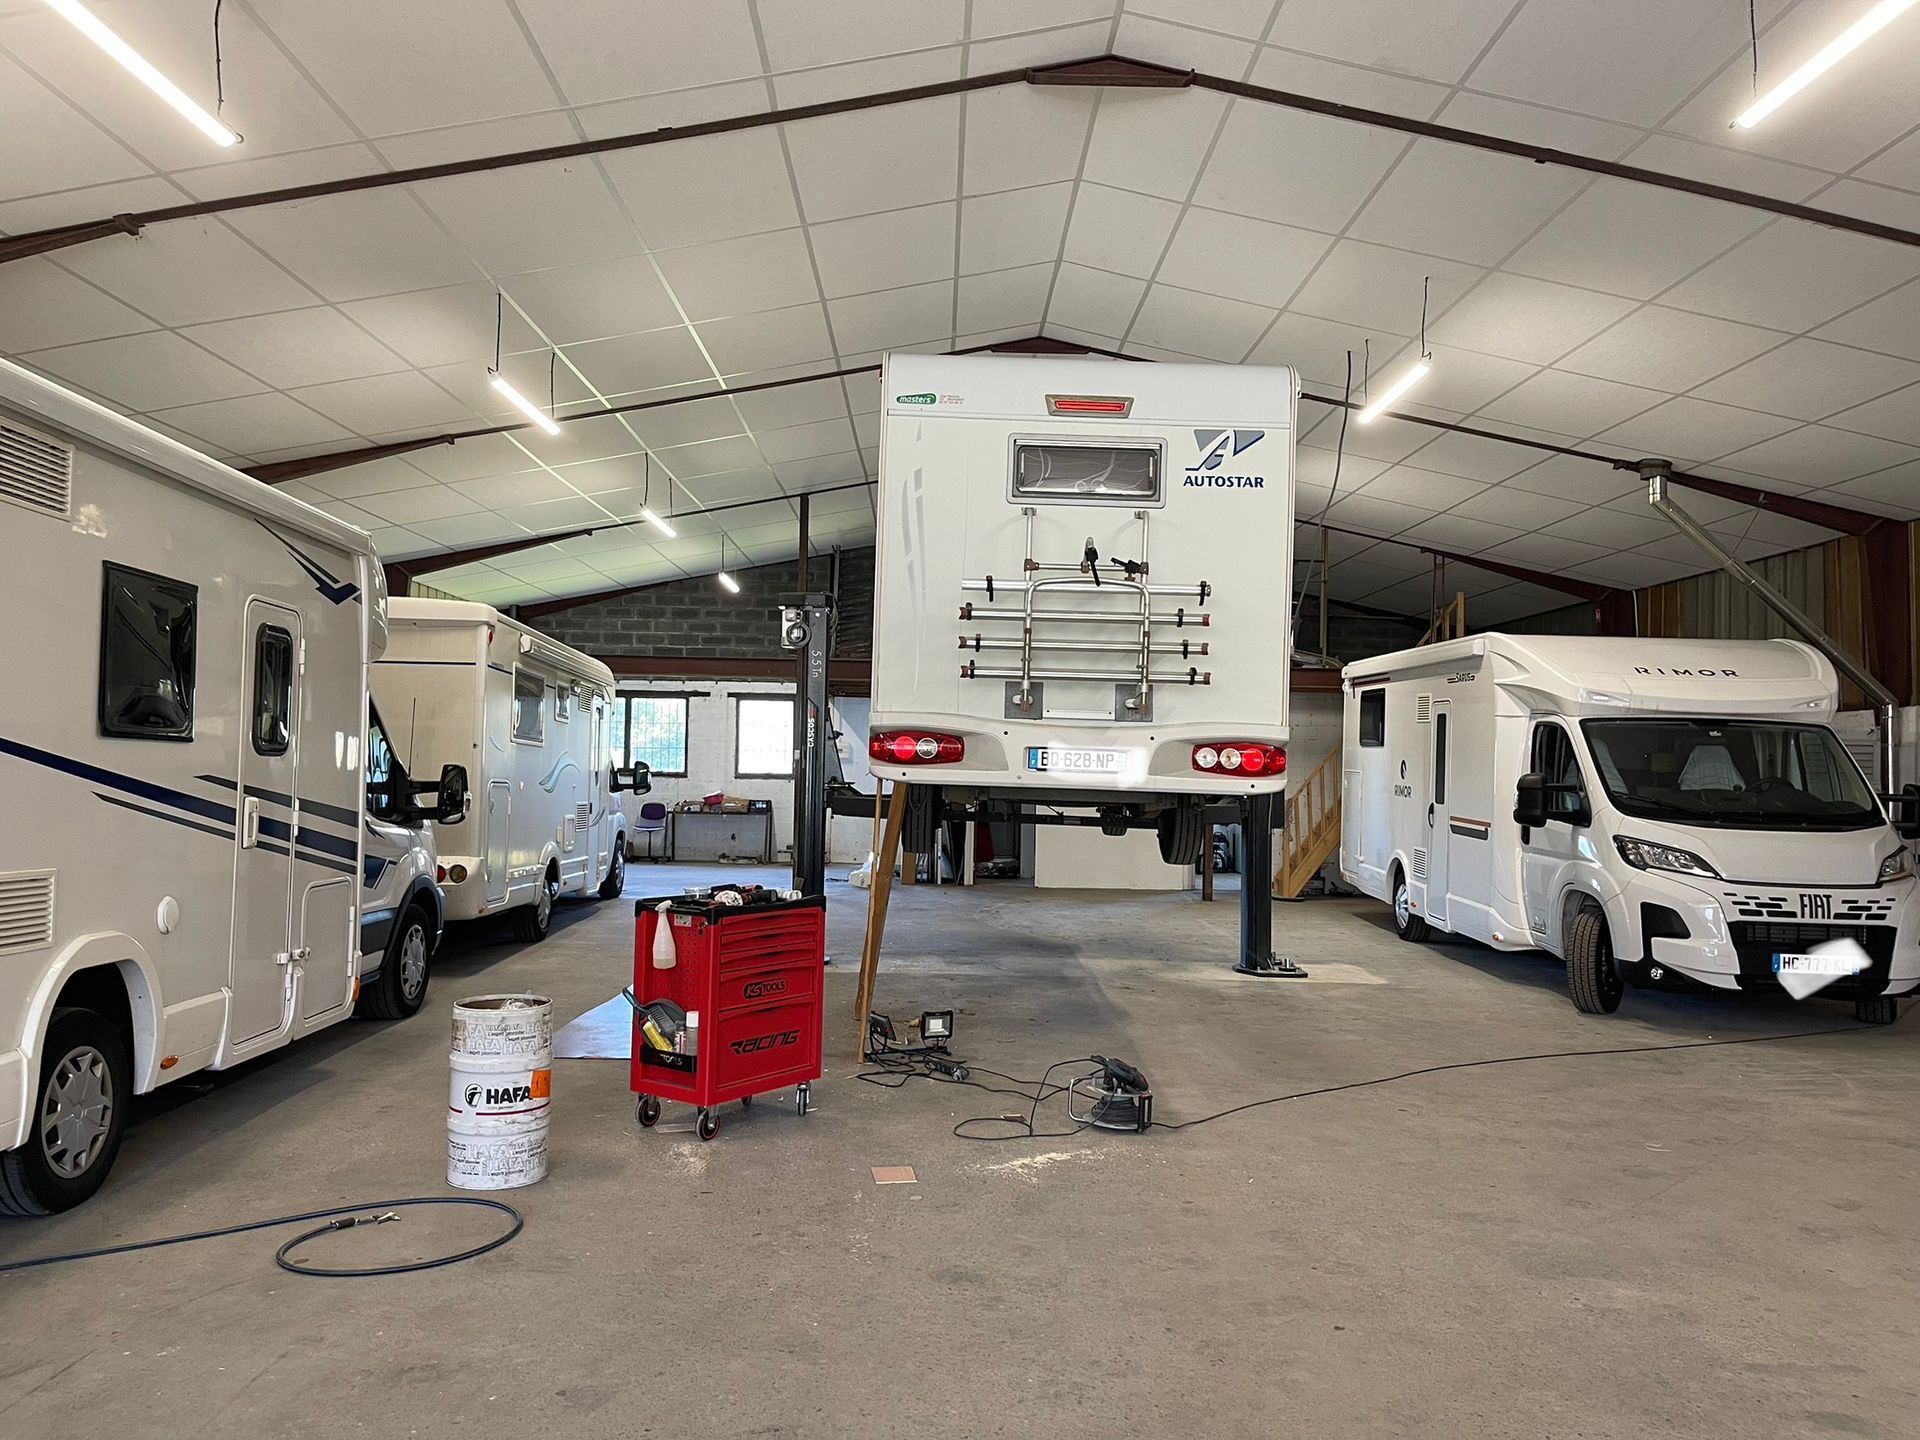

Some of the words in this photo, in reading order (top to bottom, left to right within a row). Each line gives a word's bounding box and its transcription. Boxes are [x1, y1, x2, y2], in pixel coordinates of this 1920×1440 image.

[900, 395, 933, 404] masters
[1183, 475, 1265, 488] AUTOSTAR
[1634, 666, 1740, 677] RIMOR
[1394, 784, 1412, 798] RIMOR
[1799, 893, 1832, 919] FIAT
[730, 1029, 801, 1055] RACING
[486, 1086, 534, 1105] HAFA
